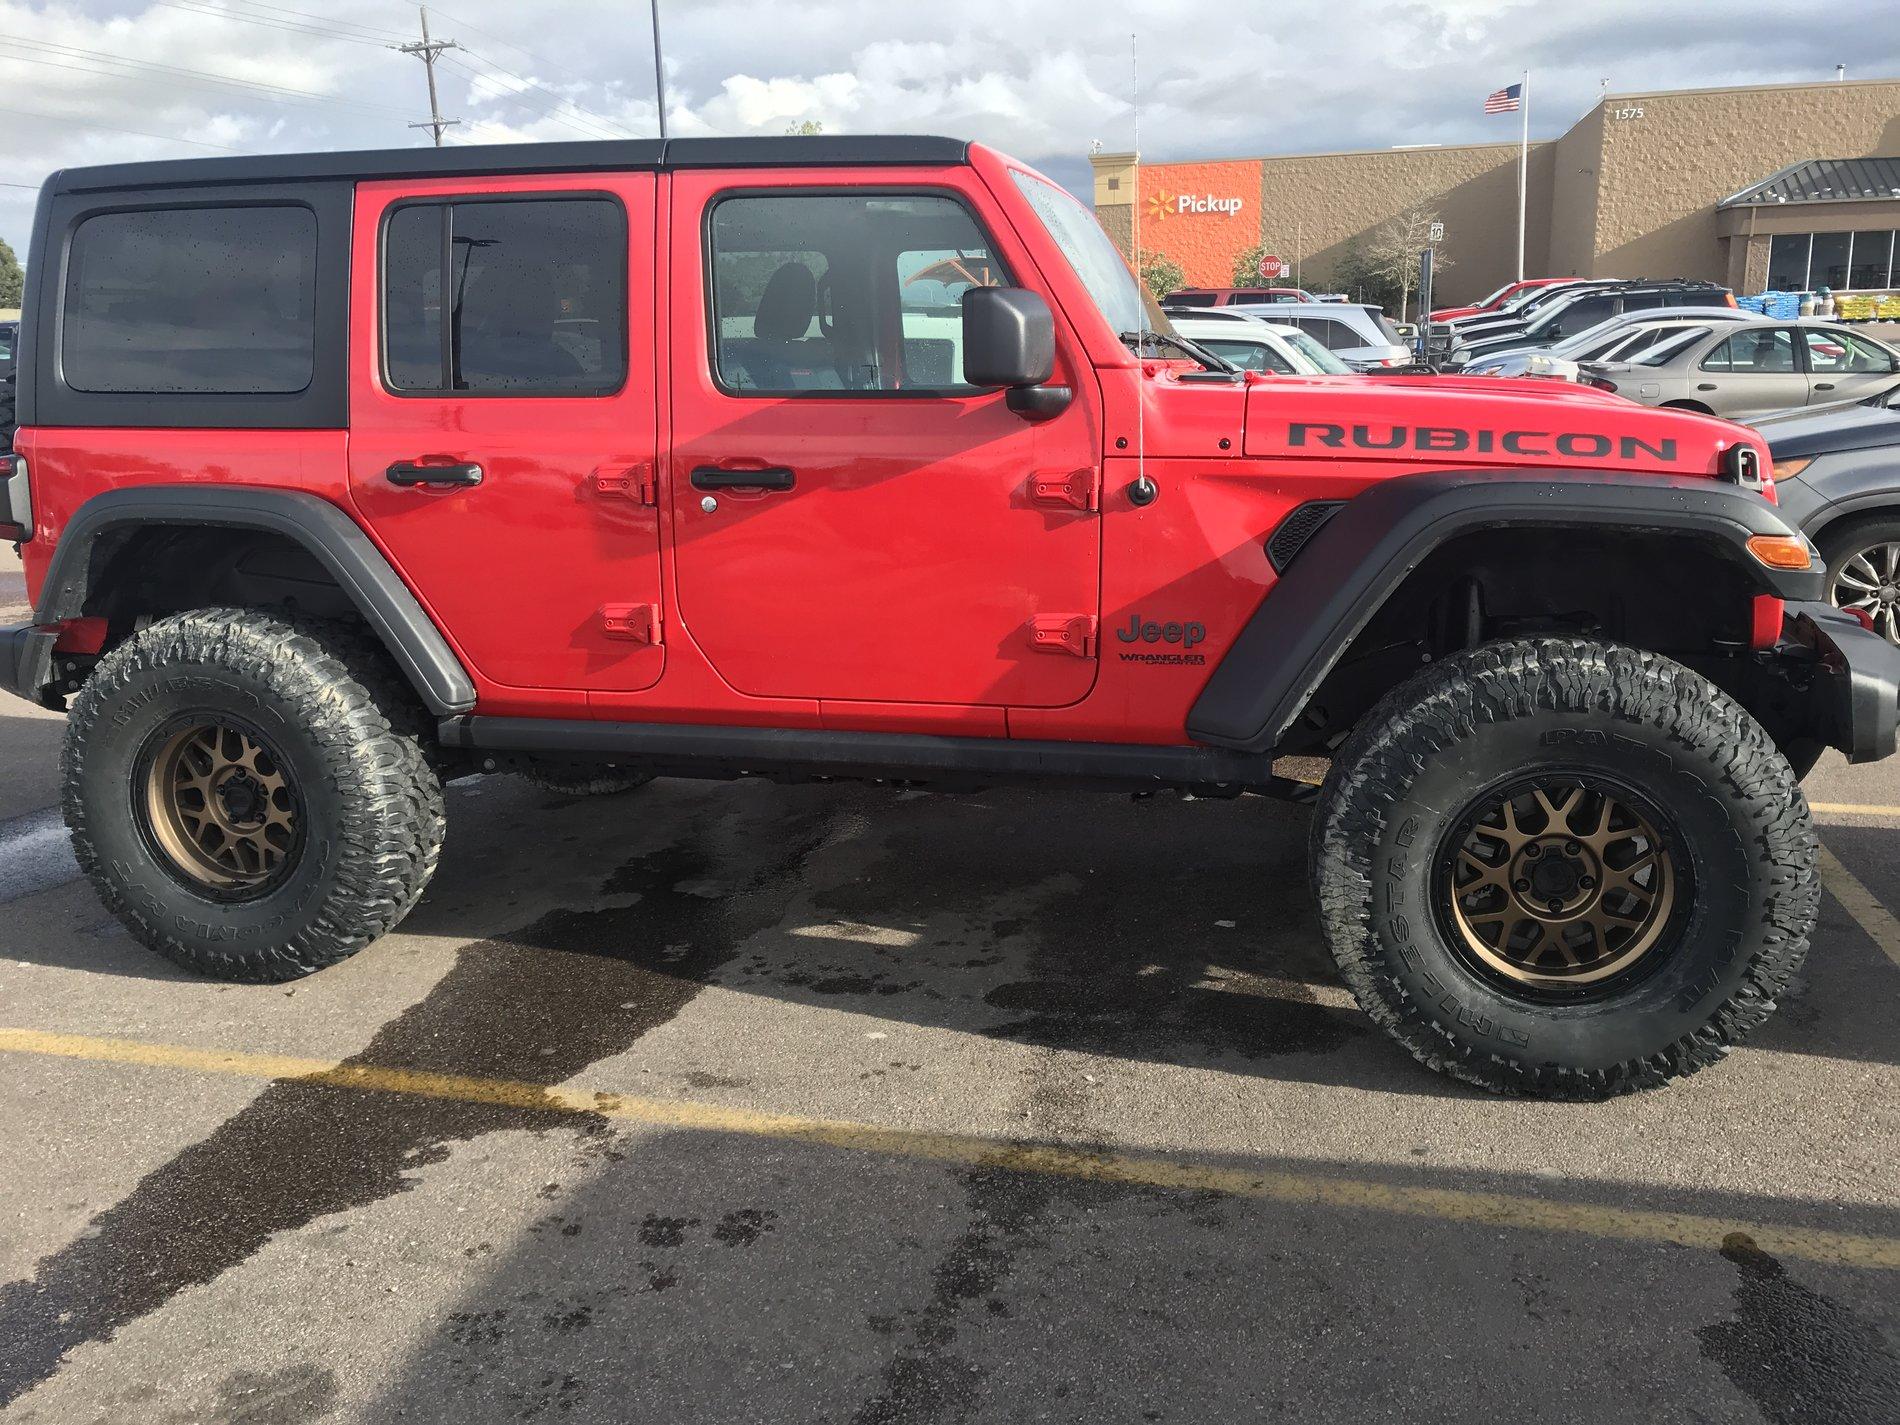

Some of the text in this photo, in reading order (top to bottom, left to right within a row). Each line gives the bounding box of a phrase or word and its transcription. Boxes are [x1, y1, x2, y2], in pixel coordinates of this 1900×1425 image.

[1615, 108, 1644, 119] 1575
[1178, 194, 1243, 216] Pickup
[1431, 227, 1442, 240] 10
[1260, 261, 1281, 271] STOP
[1287, 422, 1678, 461] RUBICON
[1117, 614, 1206, 648] Jeep
[1119, 653, 1205, 662] WRANGLER
[1386, 814, 1494, 1037] MILESTAR
